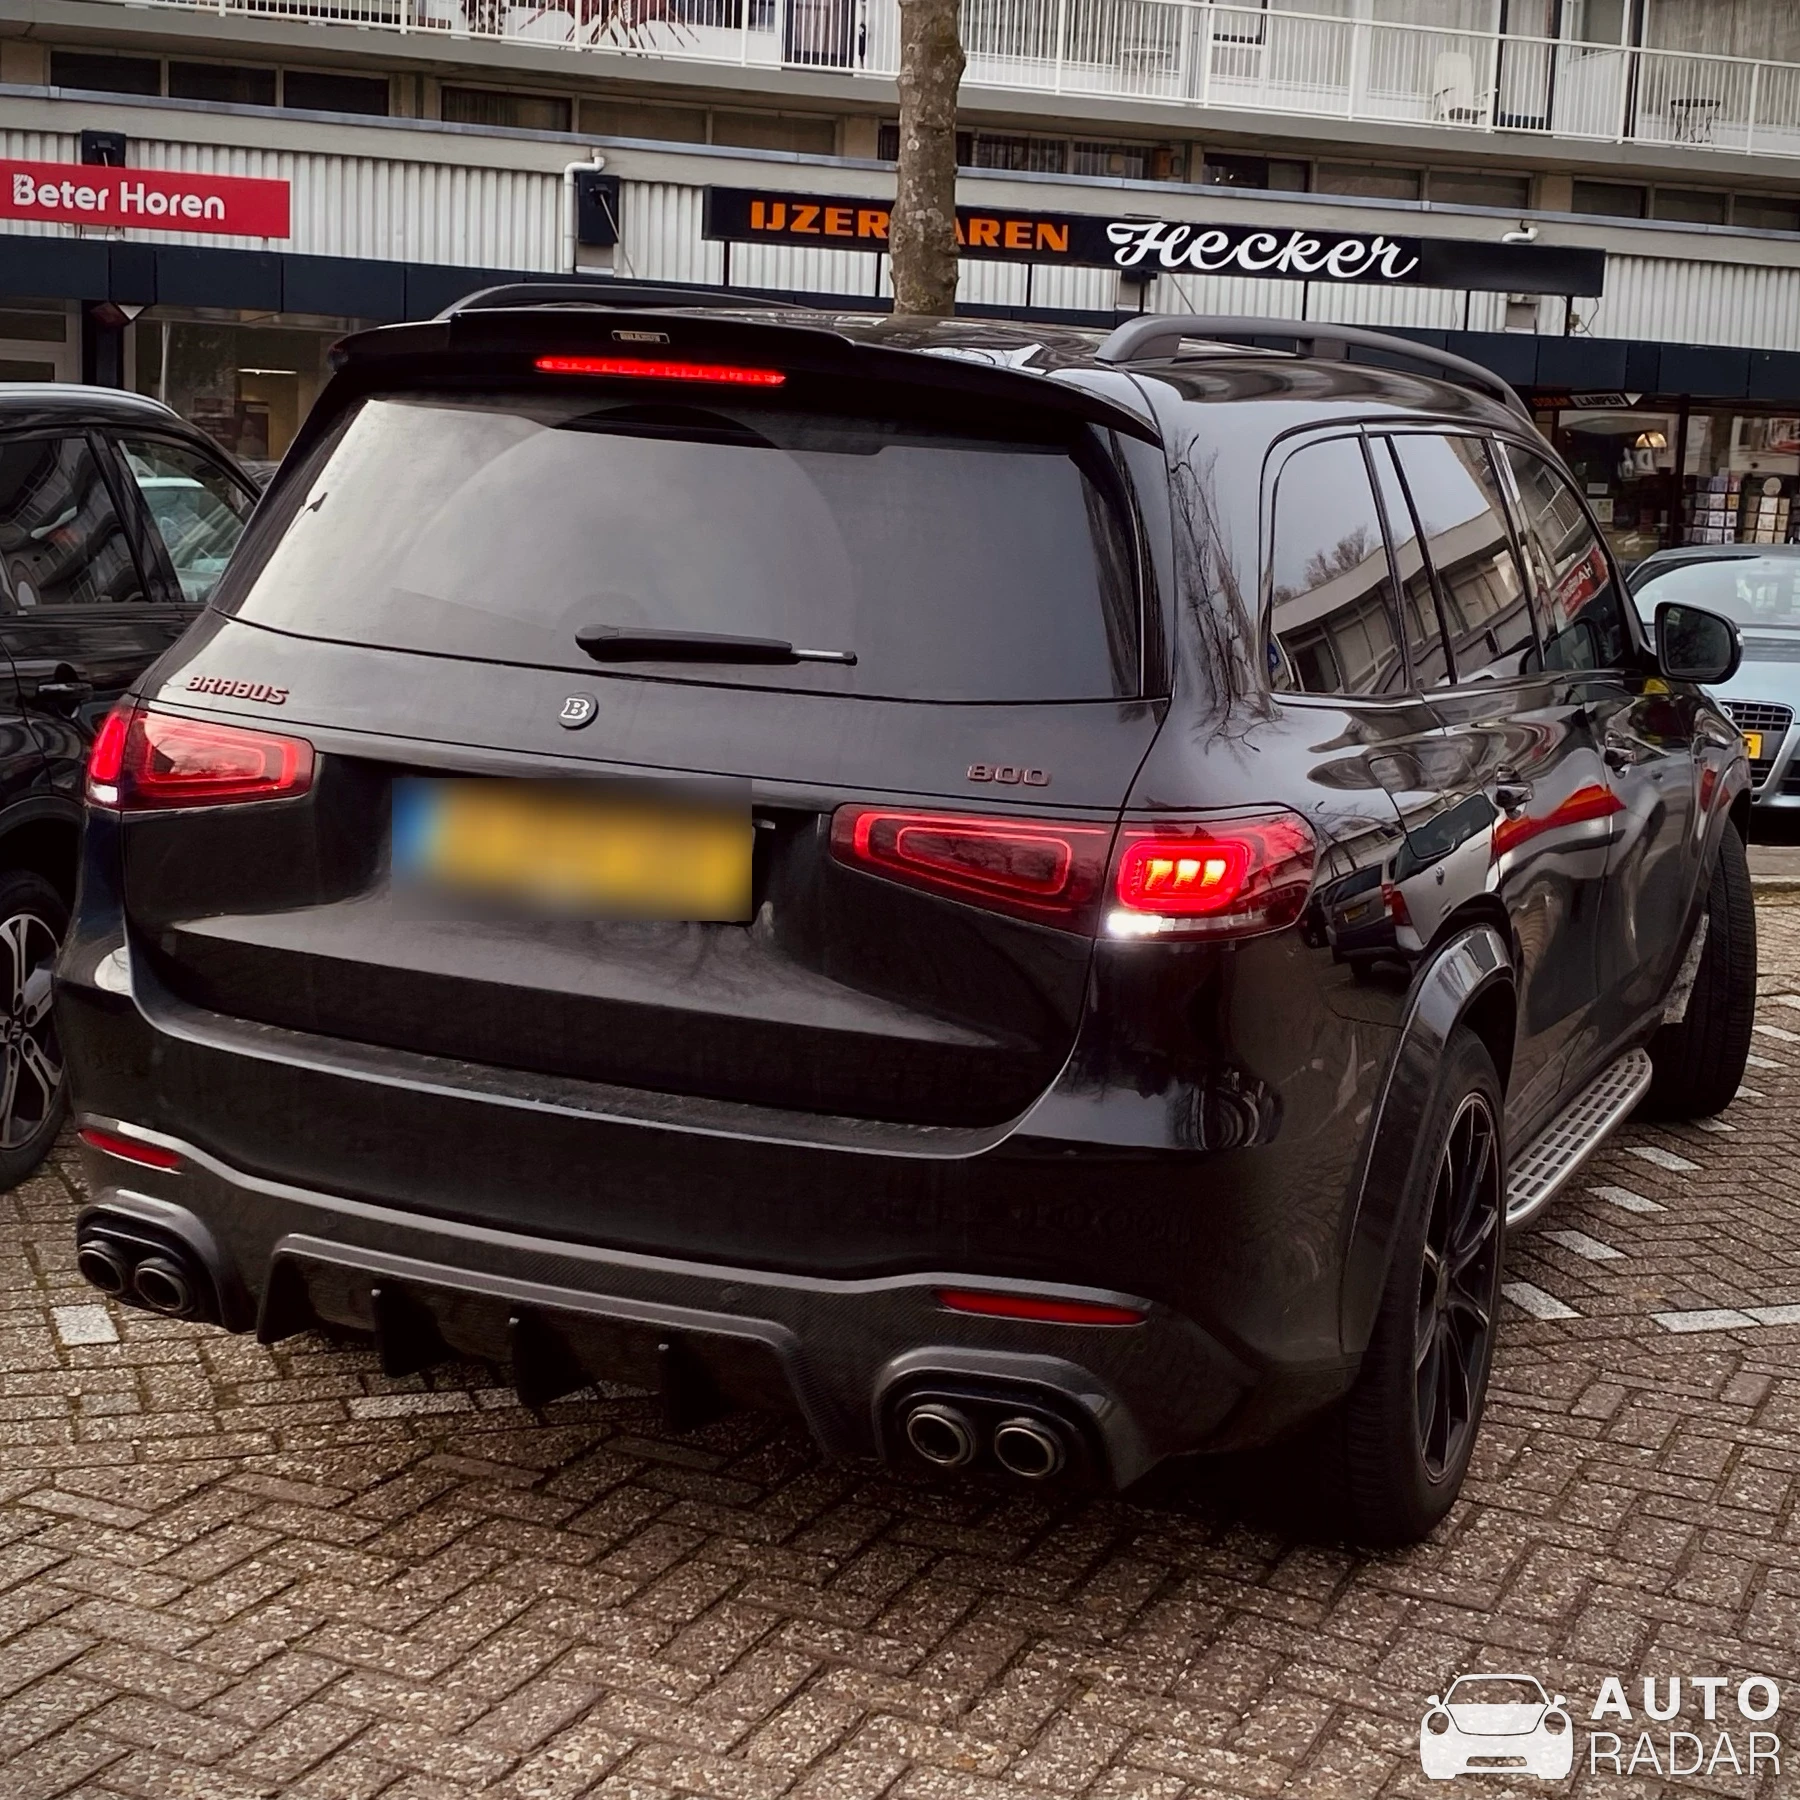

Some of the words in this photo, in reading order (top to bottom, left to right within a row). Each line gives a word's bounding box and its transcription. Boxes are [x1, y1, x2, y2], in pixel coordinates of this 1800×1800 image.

[13, 173, 109, 212] Beter
[120, 181, 225, 220] Horen
[751, 201, 1068, 251] IJZERREN
[1106, 221, 1418, 278] Hecker
[1576, 394, 1625, 406] LAMPEN
[186, 676, 290, 705] BRABUS
[560, 697, 590, 720] B
[967, 764, 1051, 787] 800
